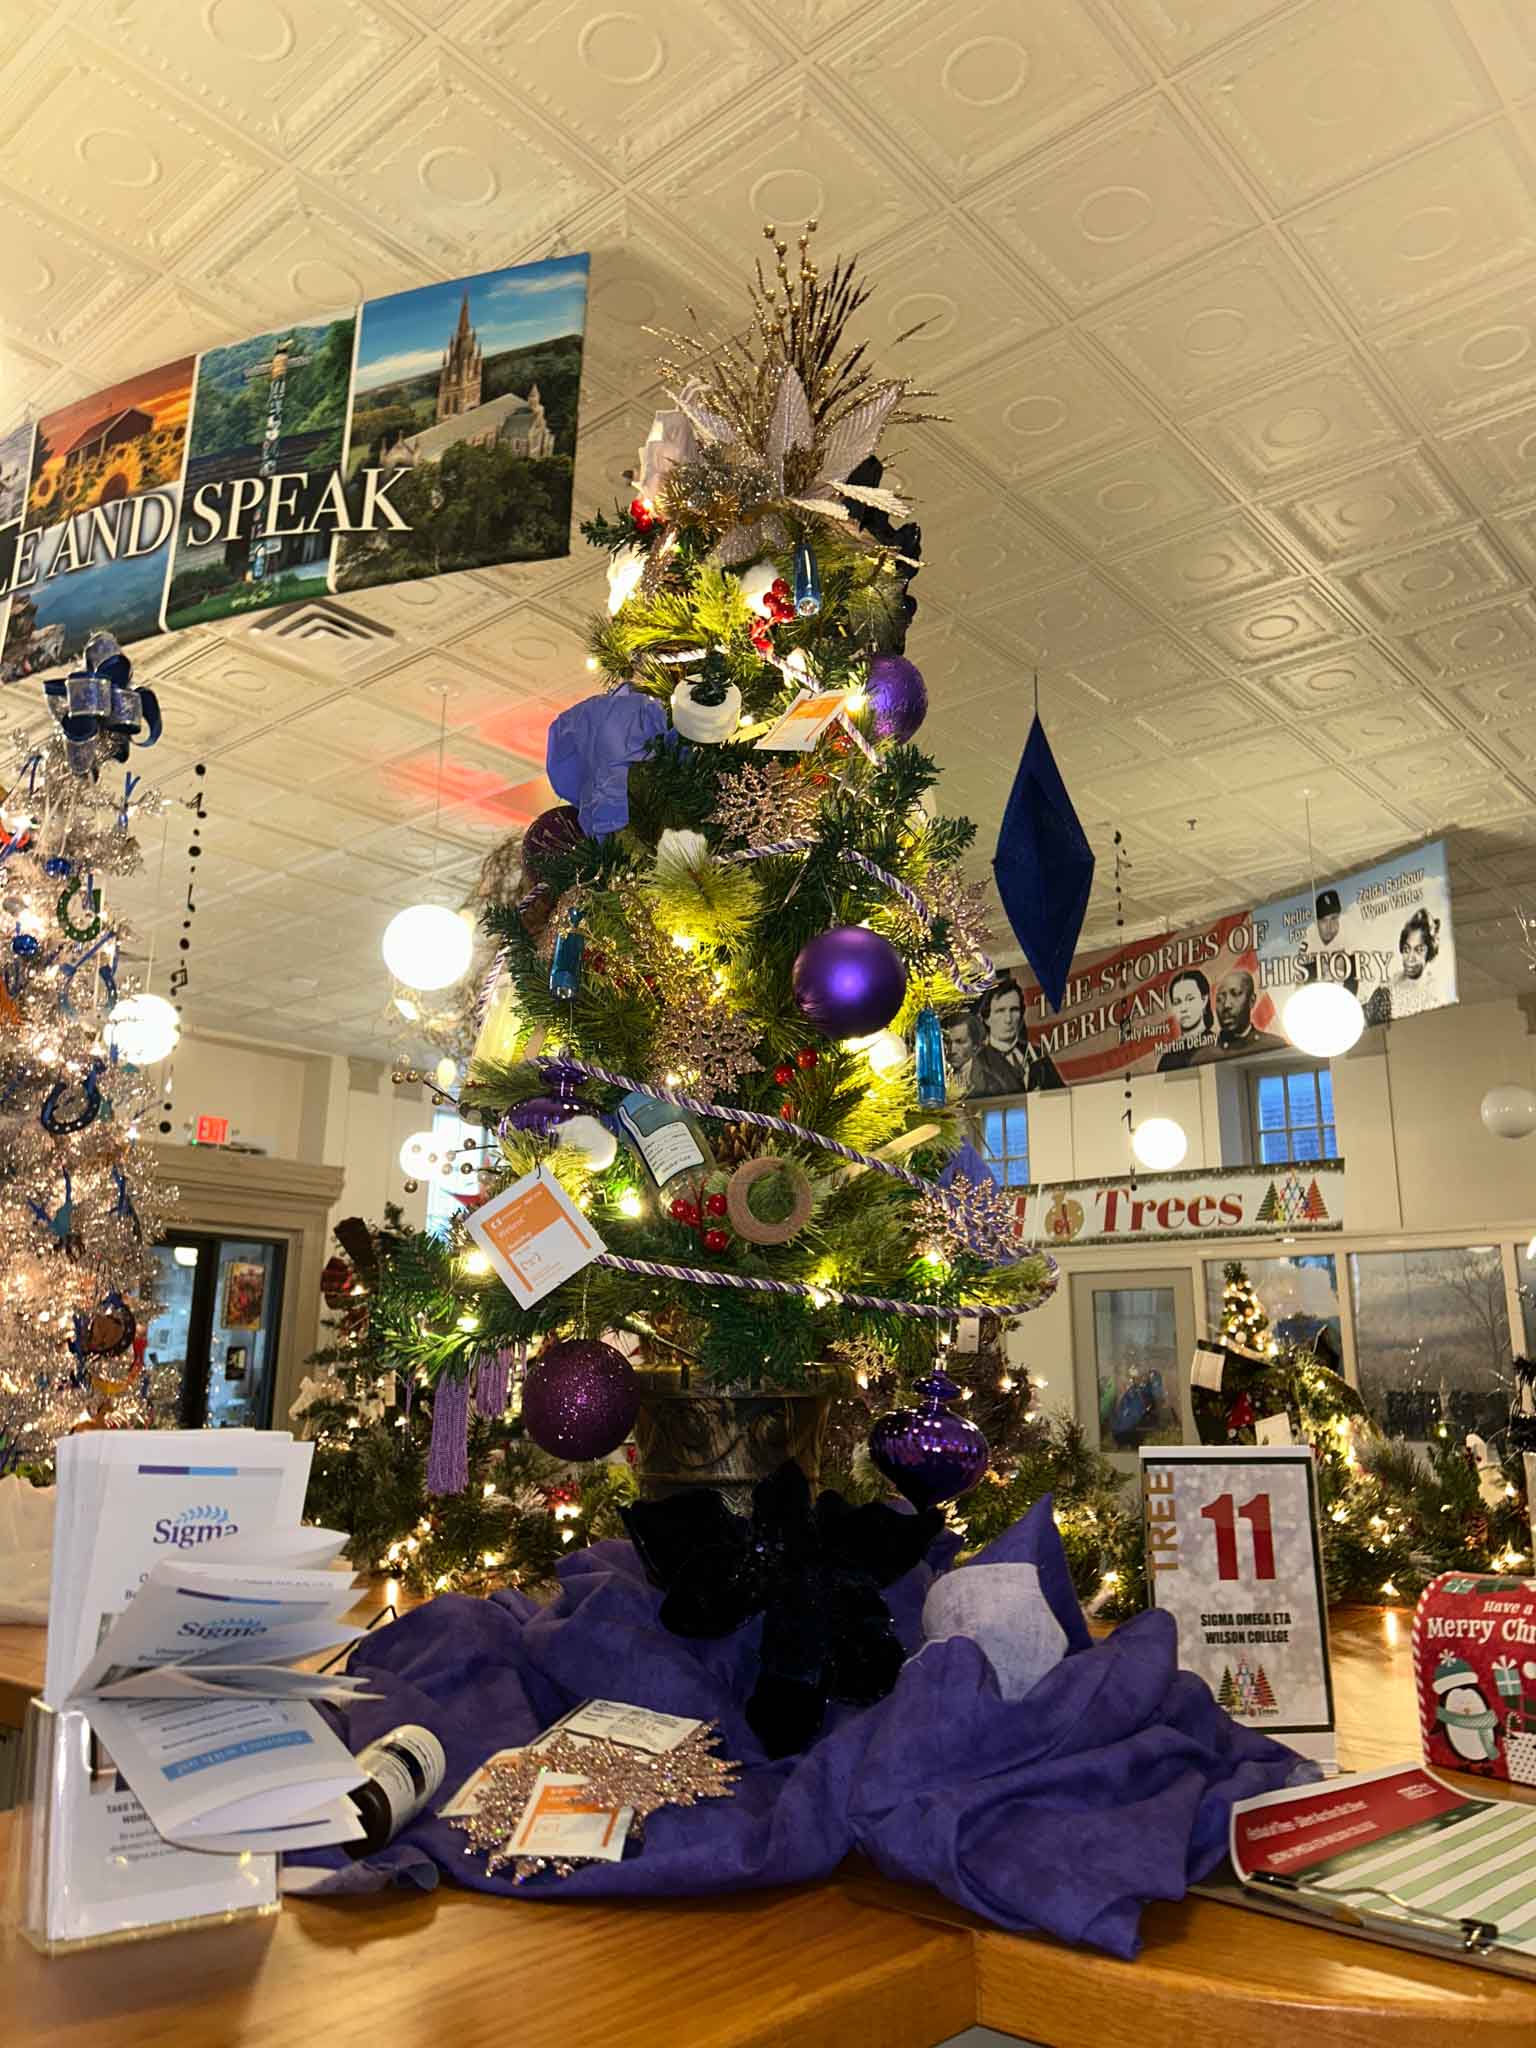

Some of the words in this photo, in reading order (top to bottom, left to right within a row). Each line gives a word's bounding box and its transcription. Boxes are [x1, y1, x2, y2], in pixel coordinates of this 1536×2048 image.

[0, 526, 42, 595] E
[45, 493, 174, 578] AND
[186, 466, 414, 546] SPEAK
[1385, 867, 1425, 894] Barbour
[1282, 905, 1313, 928] Nellie
[1288, 927, 1308, 945] Fox
[1099, 931, 1219, 993] STORIES
[1228, 919, 1269, 953] OF
[1023, 984, 1169, 1063] AMERICAN
[1259, 951, 1394, 988] HISTORY
[1118, 1023, 1143, 1043] ily
[1143, 1022, 1172, 1037] Harris
[1153, 1038, 1185, 1056] Martin
[1095, 1188, 1243, 1233] Trees
[1146, 1471, 1179, 1583] TREE
[1200, 1493, 1277, 1581] 11
[1200, 1613, 1234, 1627] SIGMA
[1236, 1612, 1272, 1626] OMEGA
[1273, 1612, 1292, 1625] ETA
[1482, 1600, 1521, 1614] Have
[1522, 1603, 1534, 1614] a
[1205, 1631, 1246, 1644] WILSON
[1248, 1630, 1290, 1643] COLLEGE
[1427, 1617, 1496, 1645] Merry
